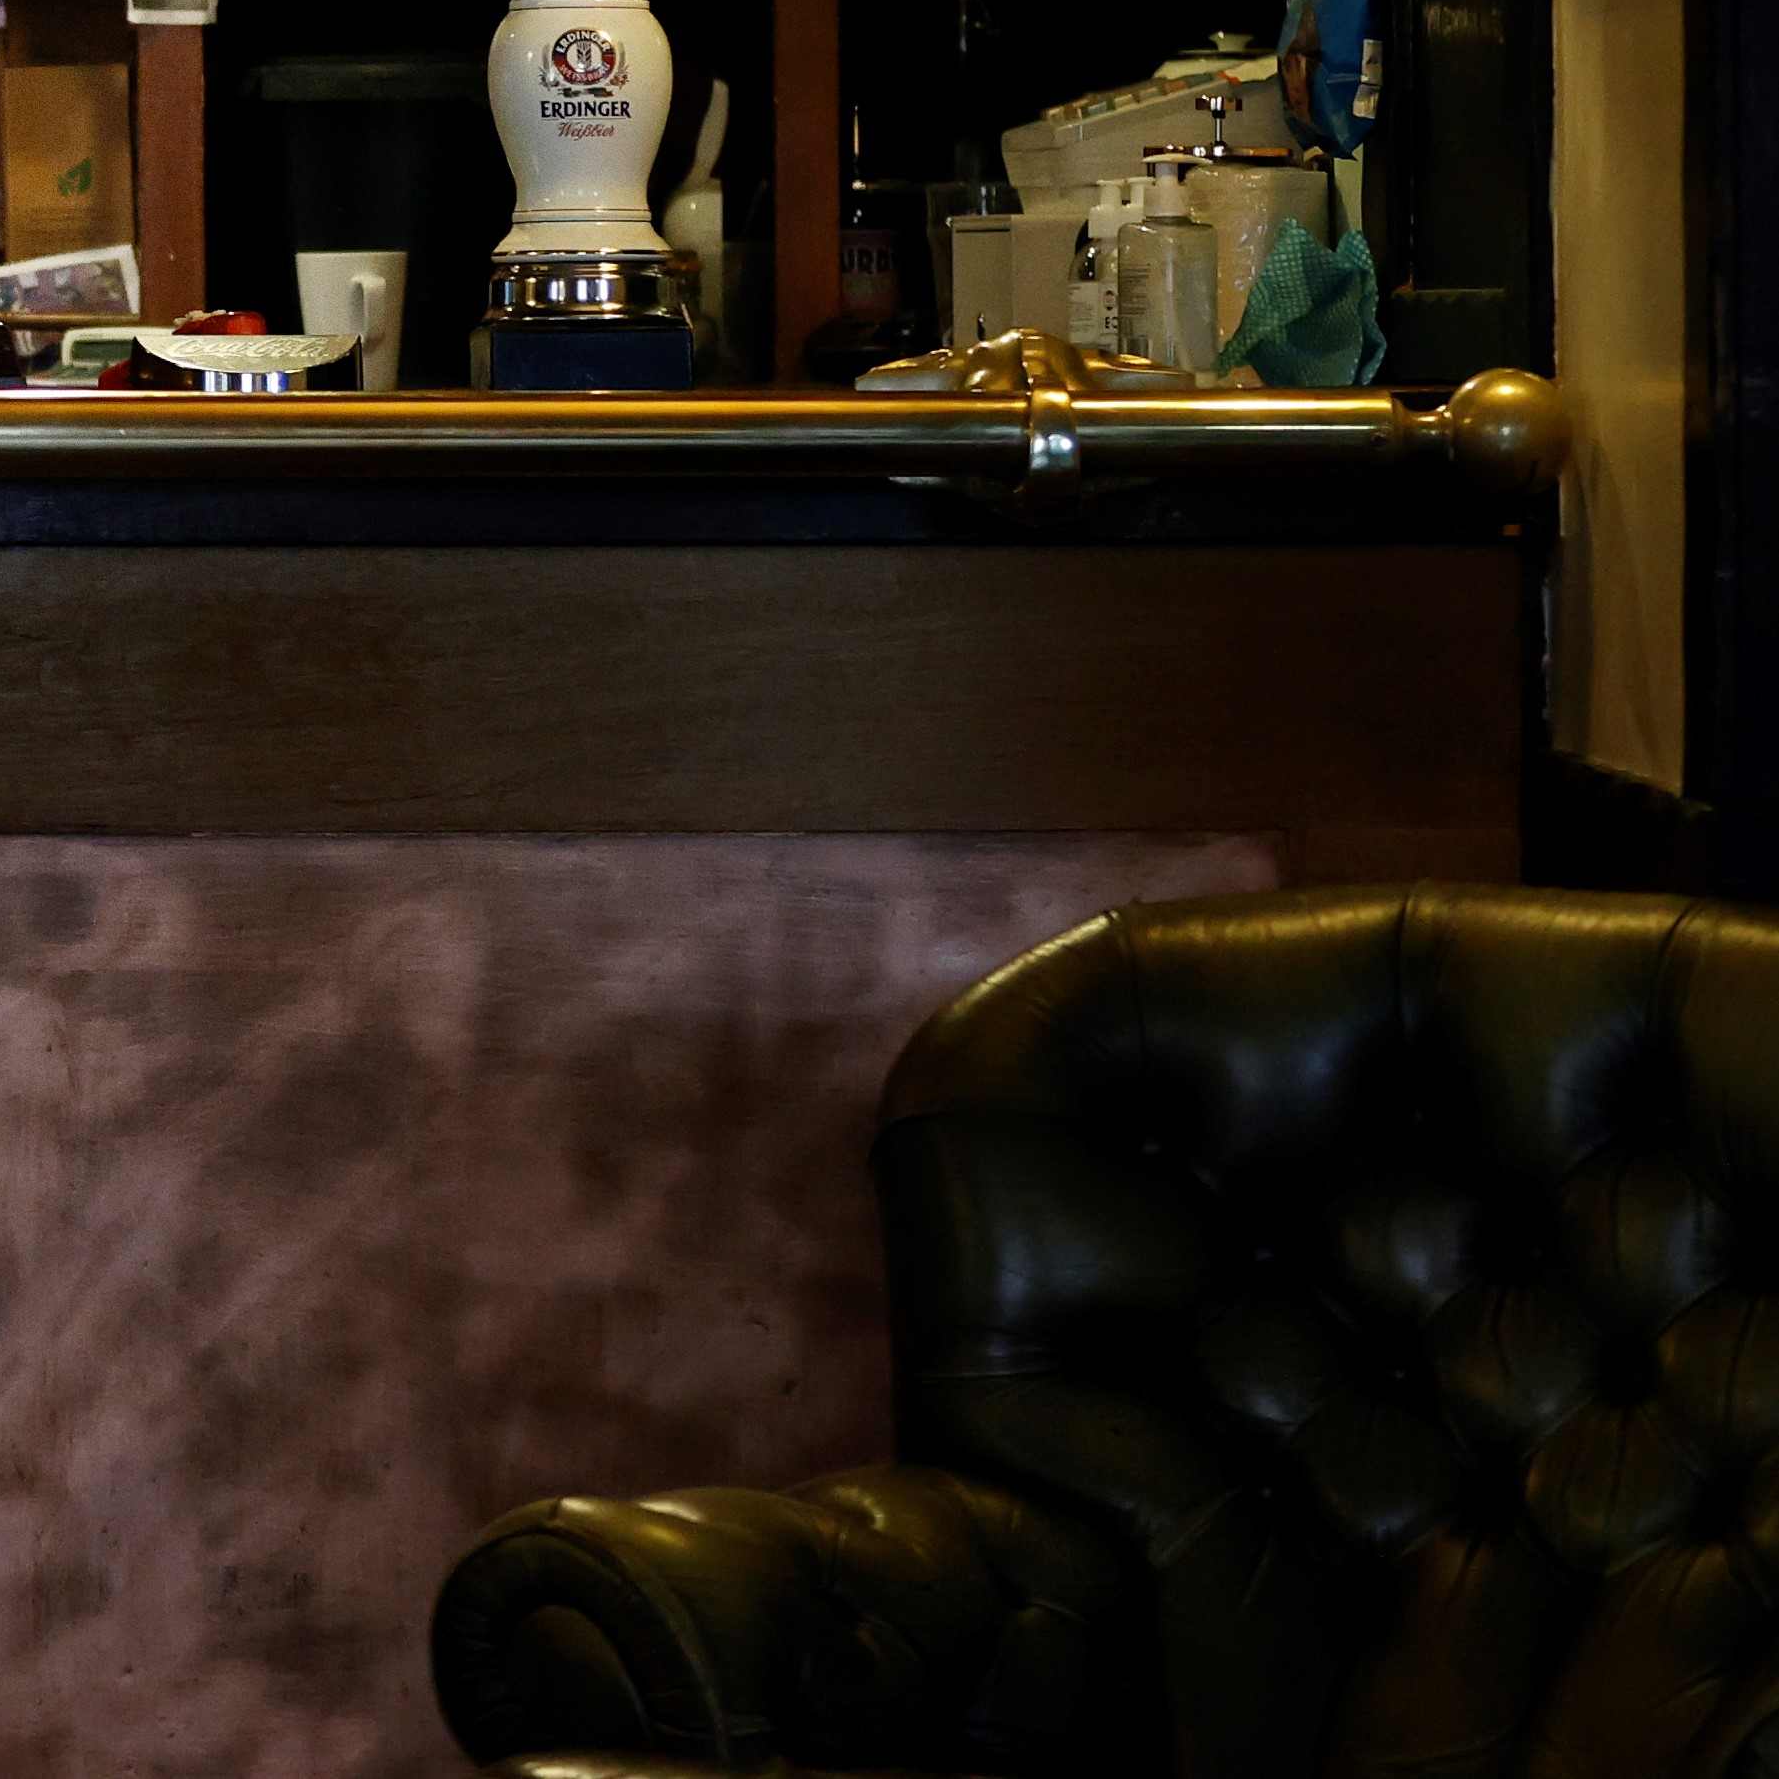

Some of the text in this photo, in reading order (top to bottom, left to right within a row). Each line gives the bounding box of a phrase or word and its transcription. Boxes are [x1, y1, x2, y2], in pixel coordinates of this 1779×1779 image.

[555, 28, 612, 55] ERDINGER
[540, 100, 632, 120] ERDINGER
[557, 121, 616, 142] Weißbier
